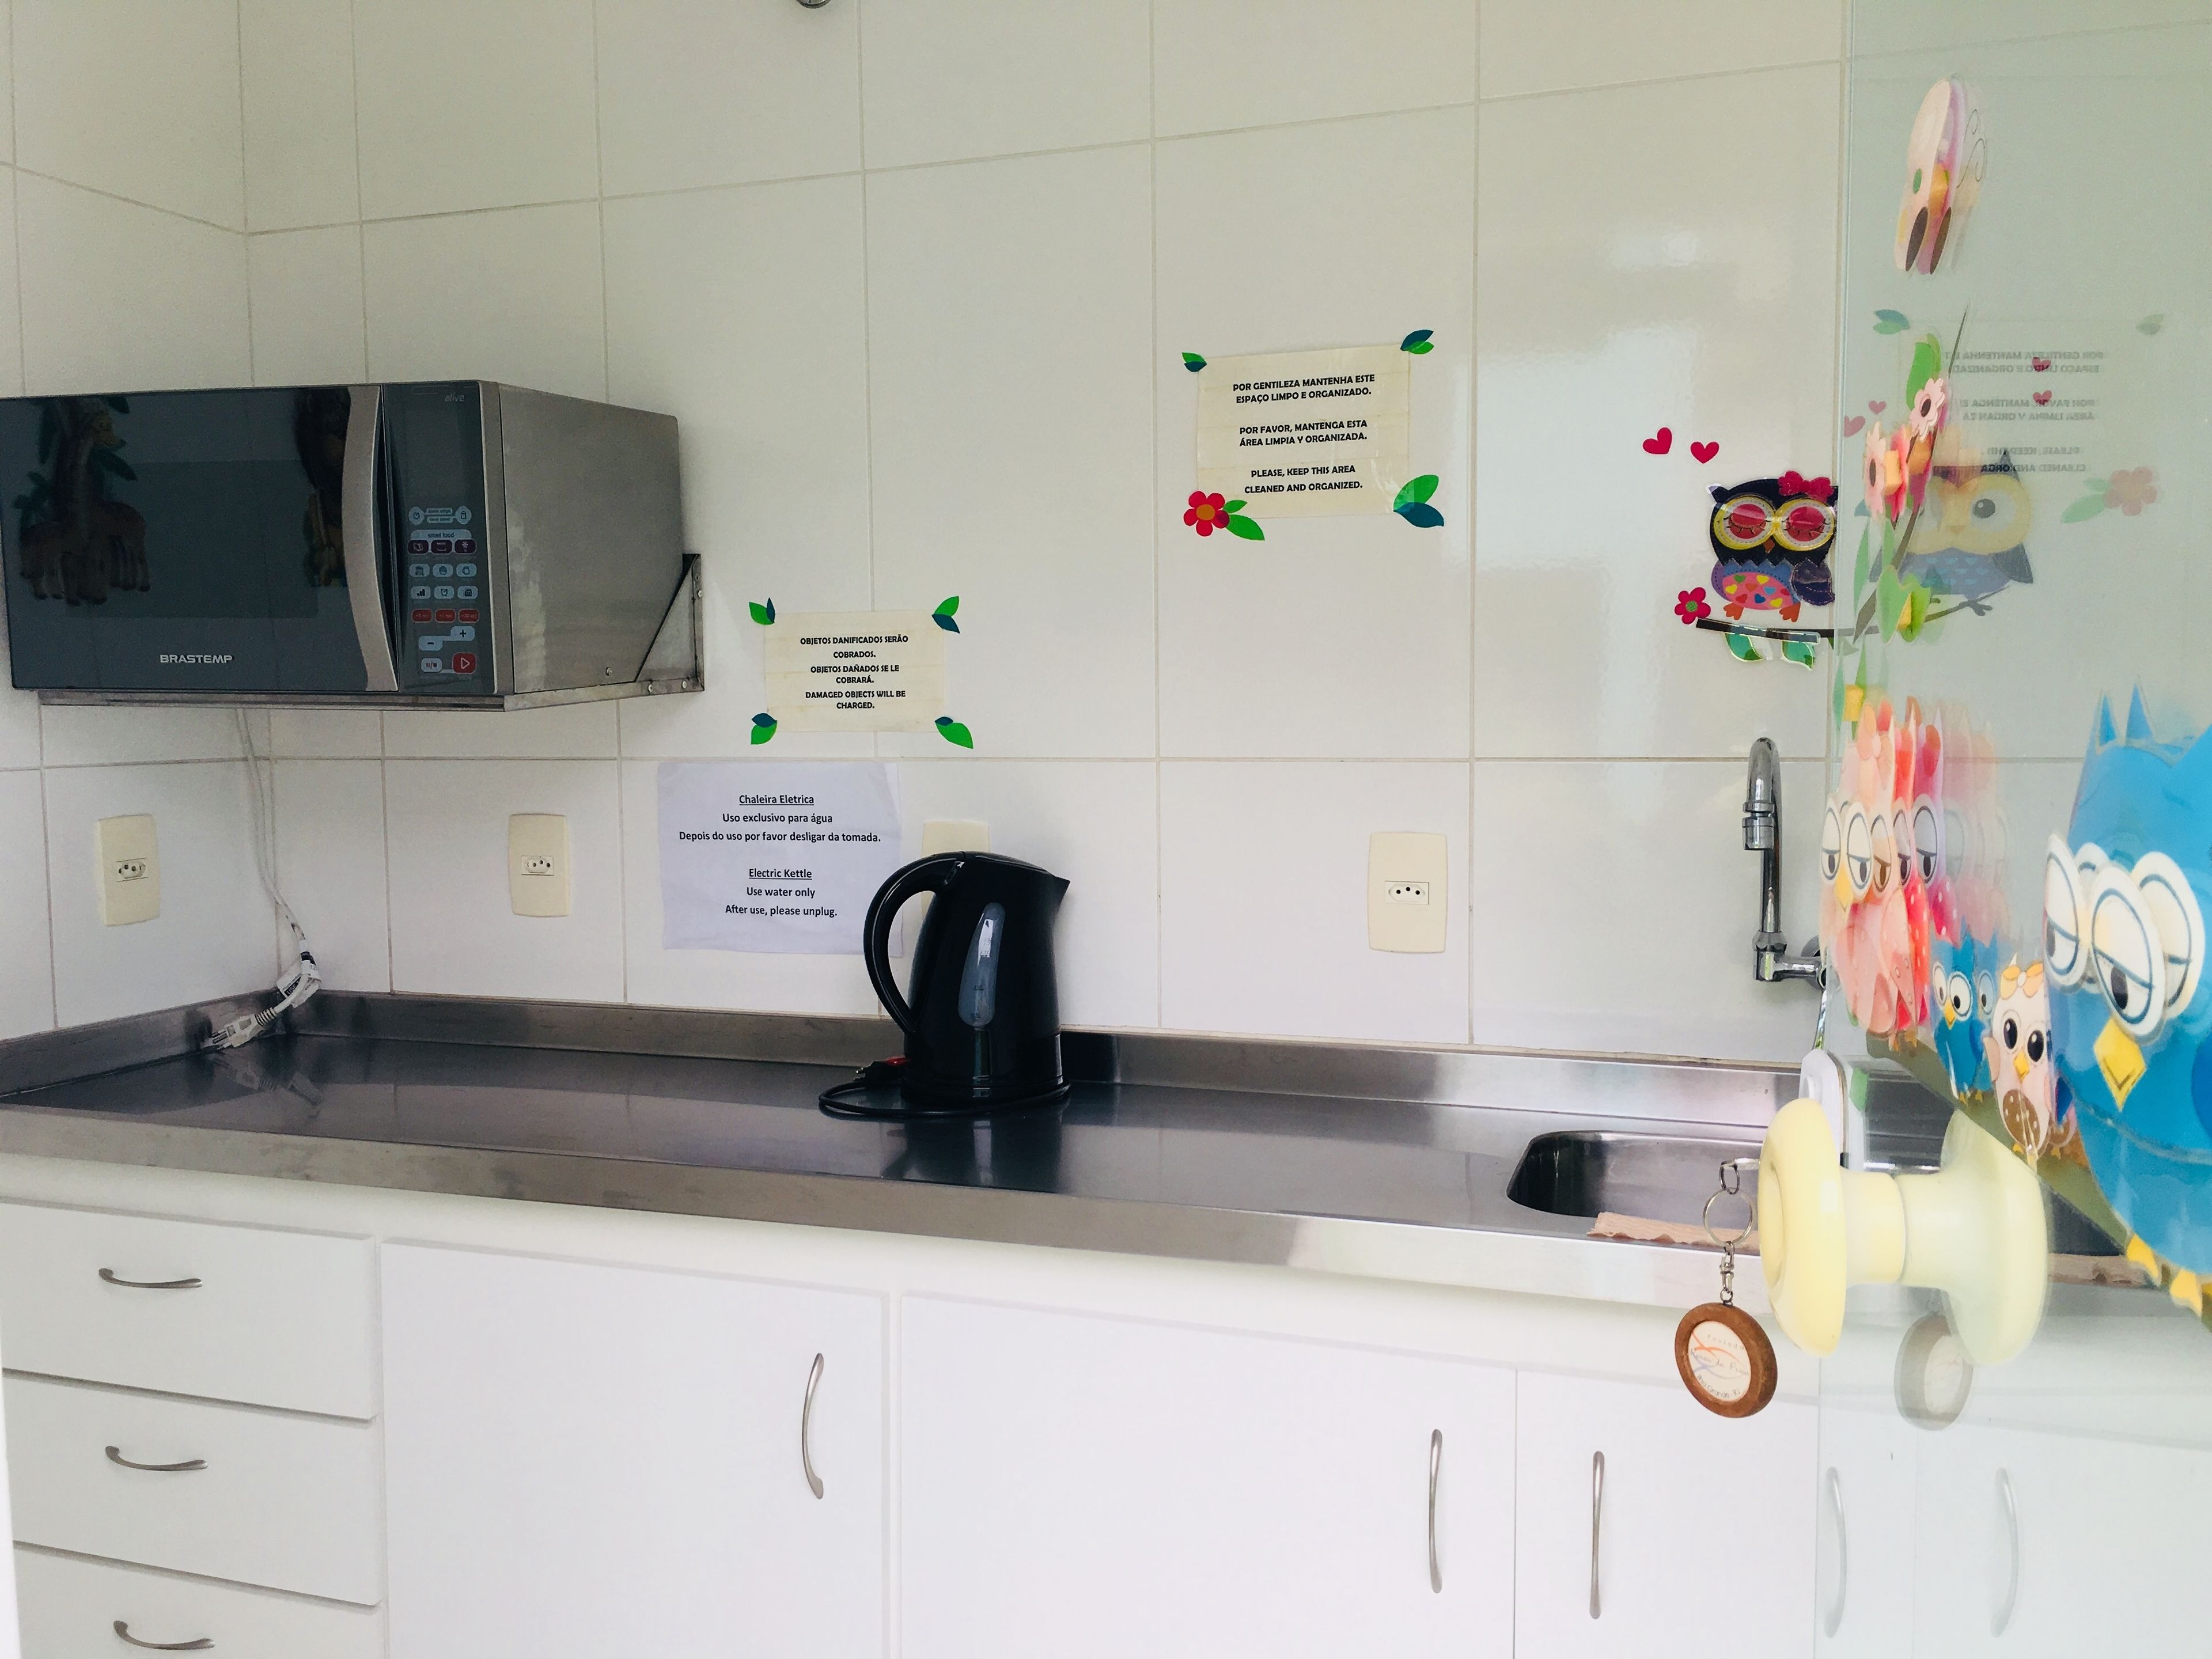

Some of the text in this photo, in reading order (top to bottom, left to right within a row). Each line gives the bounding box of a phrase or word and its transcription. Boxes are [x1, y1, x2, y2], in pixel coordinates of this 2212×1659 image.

[1233, 373, 1375, 392] POR GENTILEZA MANTENHA ESTE
[1236, 387, 1372, 404] ESPAÇO LIMPO E ORGANIZADO.
[1239, 419, 1368, 435] POR FAVOR, MANTENGA ESTA
[1239, 431, 1368, 447] ÁREA LIMPIA Y ORGANIZADA.
[1251, 464, 1356, 478] PLEASE, KEEP THIS AREA
[1244, 480, 1363, 494] CLEANED AND ORGANIZED.
[800, 634, 909, 646] OBJETOS DANIFICADOS SERÃO
[160, 654, 233, 663] BRASTEMP
[832, 650, 876, 659] COBRADOS.
[810, 664, 900, 674] OBJETOS DAÑADOS SE LE
[835, 675, 874, 684] COBRARÁ.
[805, 691, 843, 699] DAMAGED
[844, 690, 875, 699] OBJECTS
[876, 690, 895, 698] WILL
[836, 702, 875, 710] CHARGED.
[738, 794, 815, 804] Chaleira Eletrica
[722, 812, 833, 825] Uso exclusivo para água
[679, 831, 711, 842] Depois
[712, 831, 725, 840] do
[744, 834, 761, 843] por
[762, 831, 787, 841] favor
[789, 831, 826, 843] desligar
[828, 832, 840, 842] da
[841, 832, 881, 842] tomada.
[748, 868, 812, 878] Electric Kettle
[747, 887, 816, 899] Use water only
[725, 904, 838, 918] After use, please unplug.
